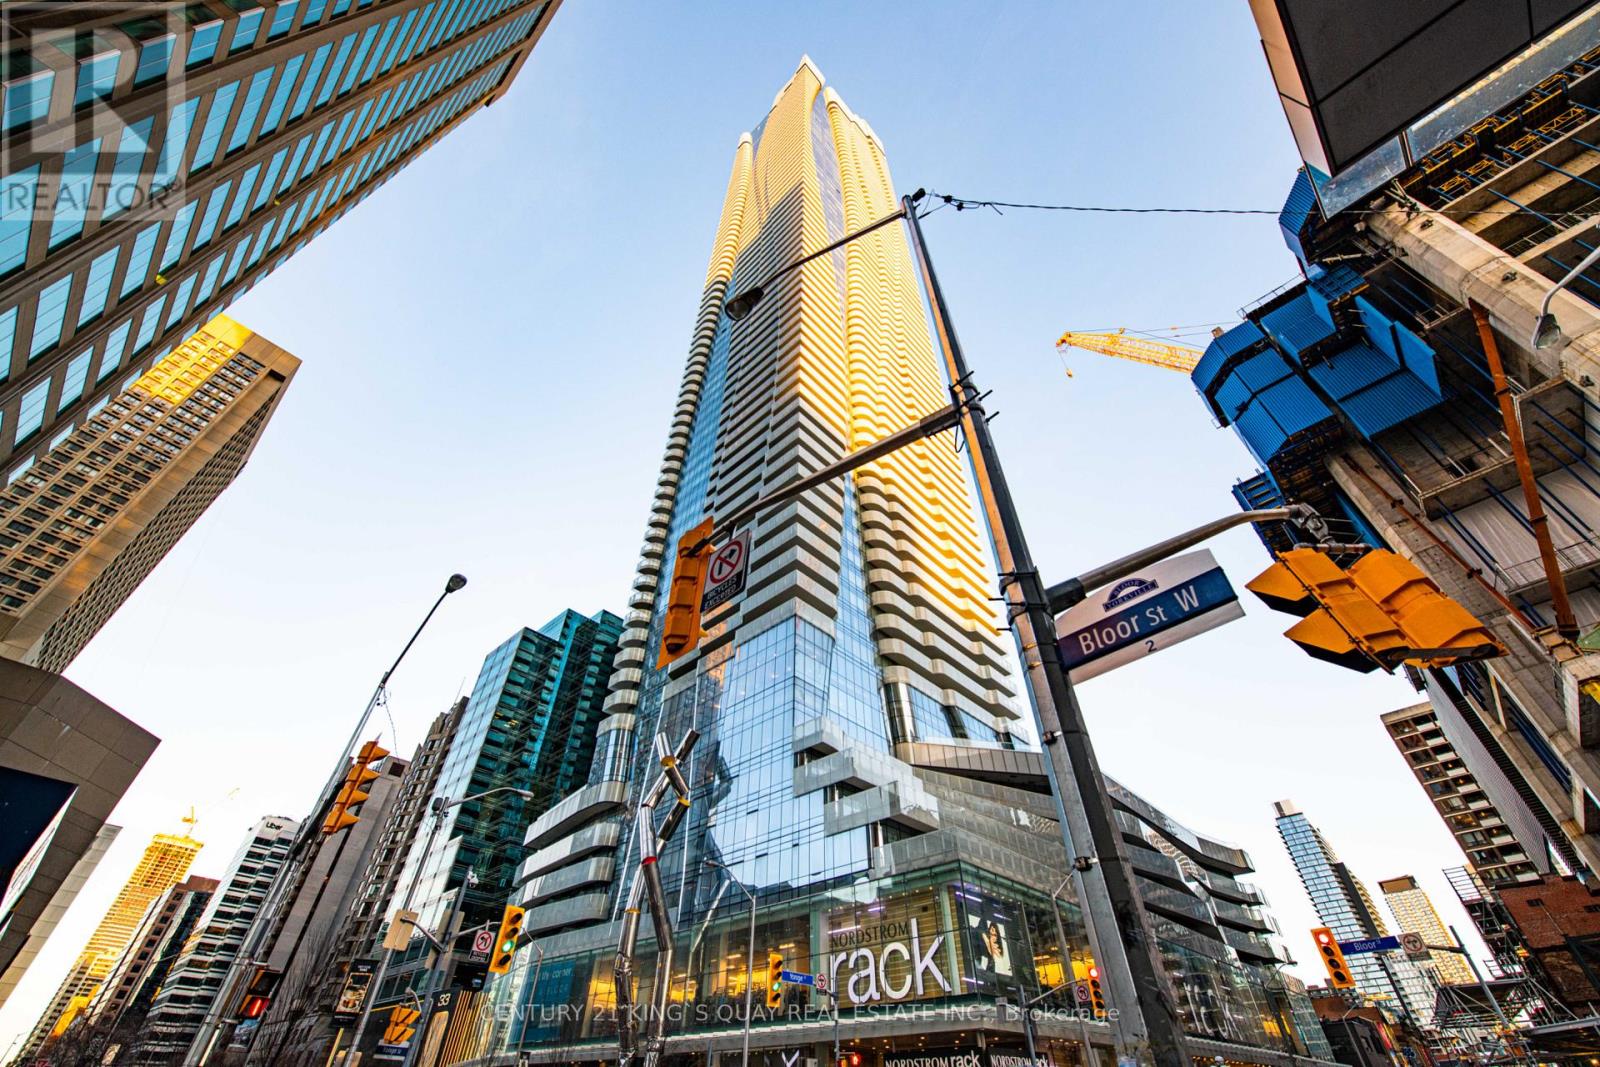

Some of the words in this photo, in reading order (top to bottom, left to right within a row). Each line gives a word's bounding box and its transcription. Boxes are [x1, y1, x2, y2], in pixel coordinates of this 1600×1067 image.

[1105, 582, 1154, 609] YORKVILLE
[1113, 579, 1140, 596] BLOOR
[1078, 616, 1141, 656] Bloor
[1146, 605, 1168, 627] St
[1173, 584, 1200, 612] W
[1145, 639, 1157, 653] 2
[265, 821, 283, 831] Uber
[831, 922, 909, 948] NORDSTROM
[1353, 942, 1377, 952] Bloor
[829, 917, 952, 1006] rack
[437, 993, 451, 1007] 33
[950, 1049, 981, 1067] rack
